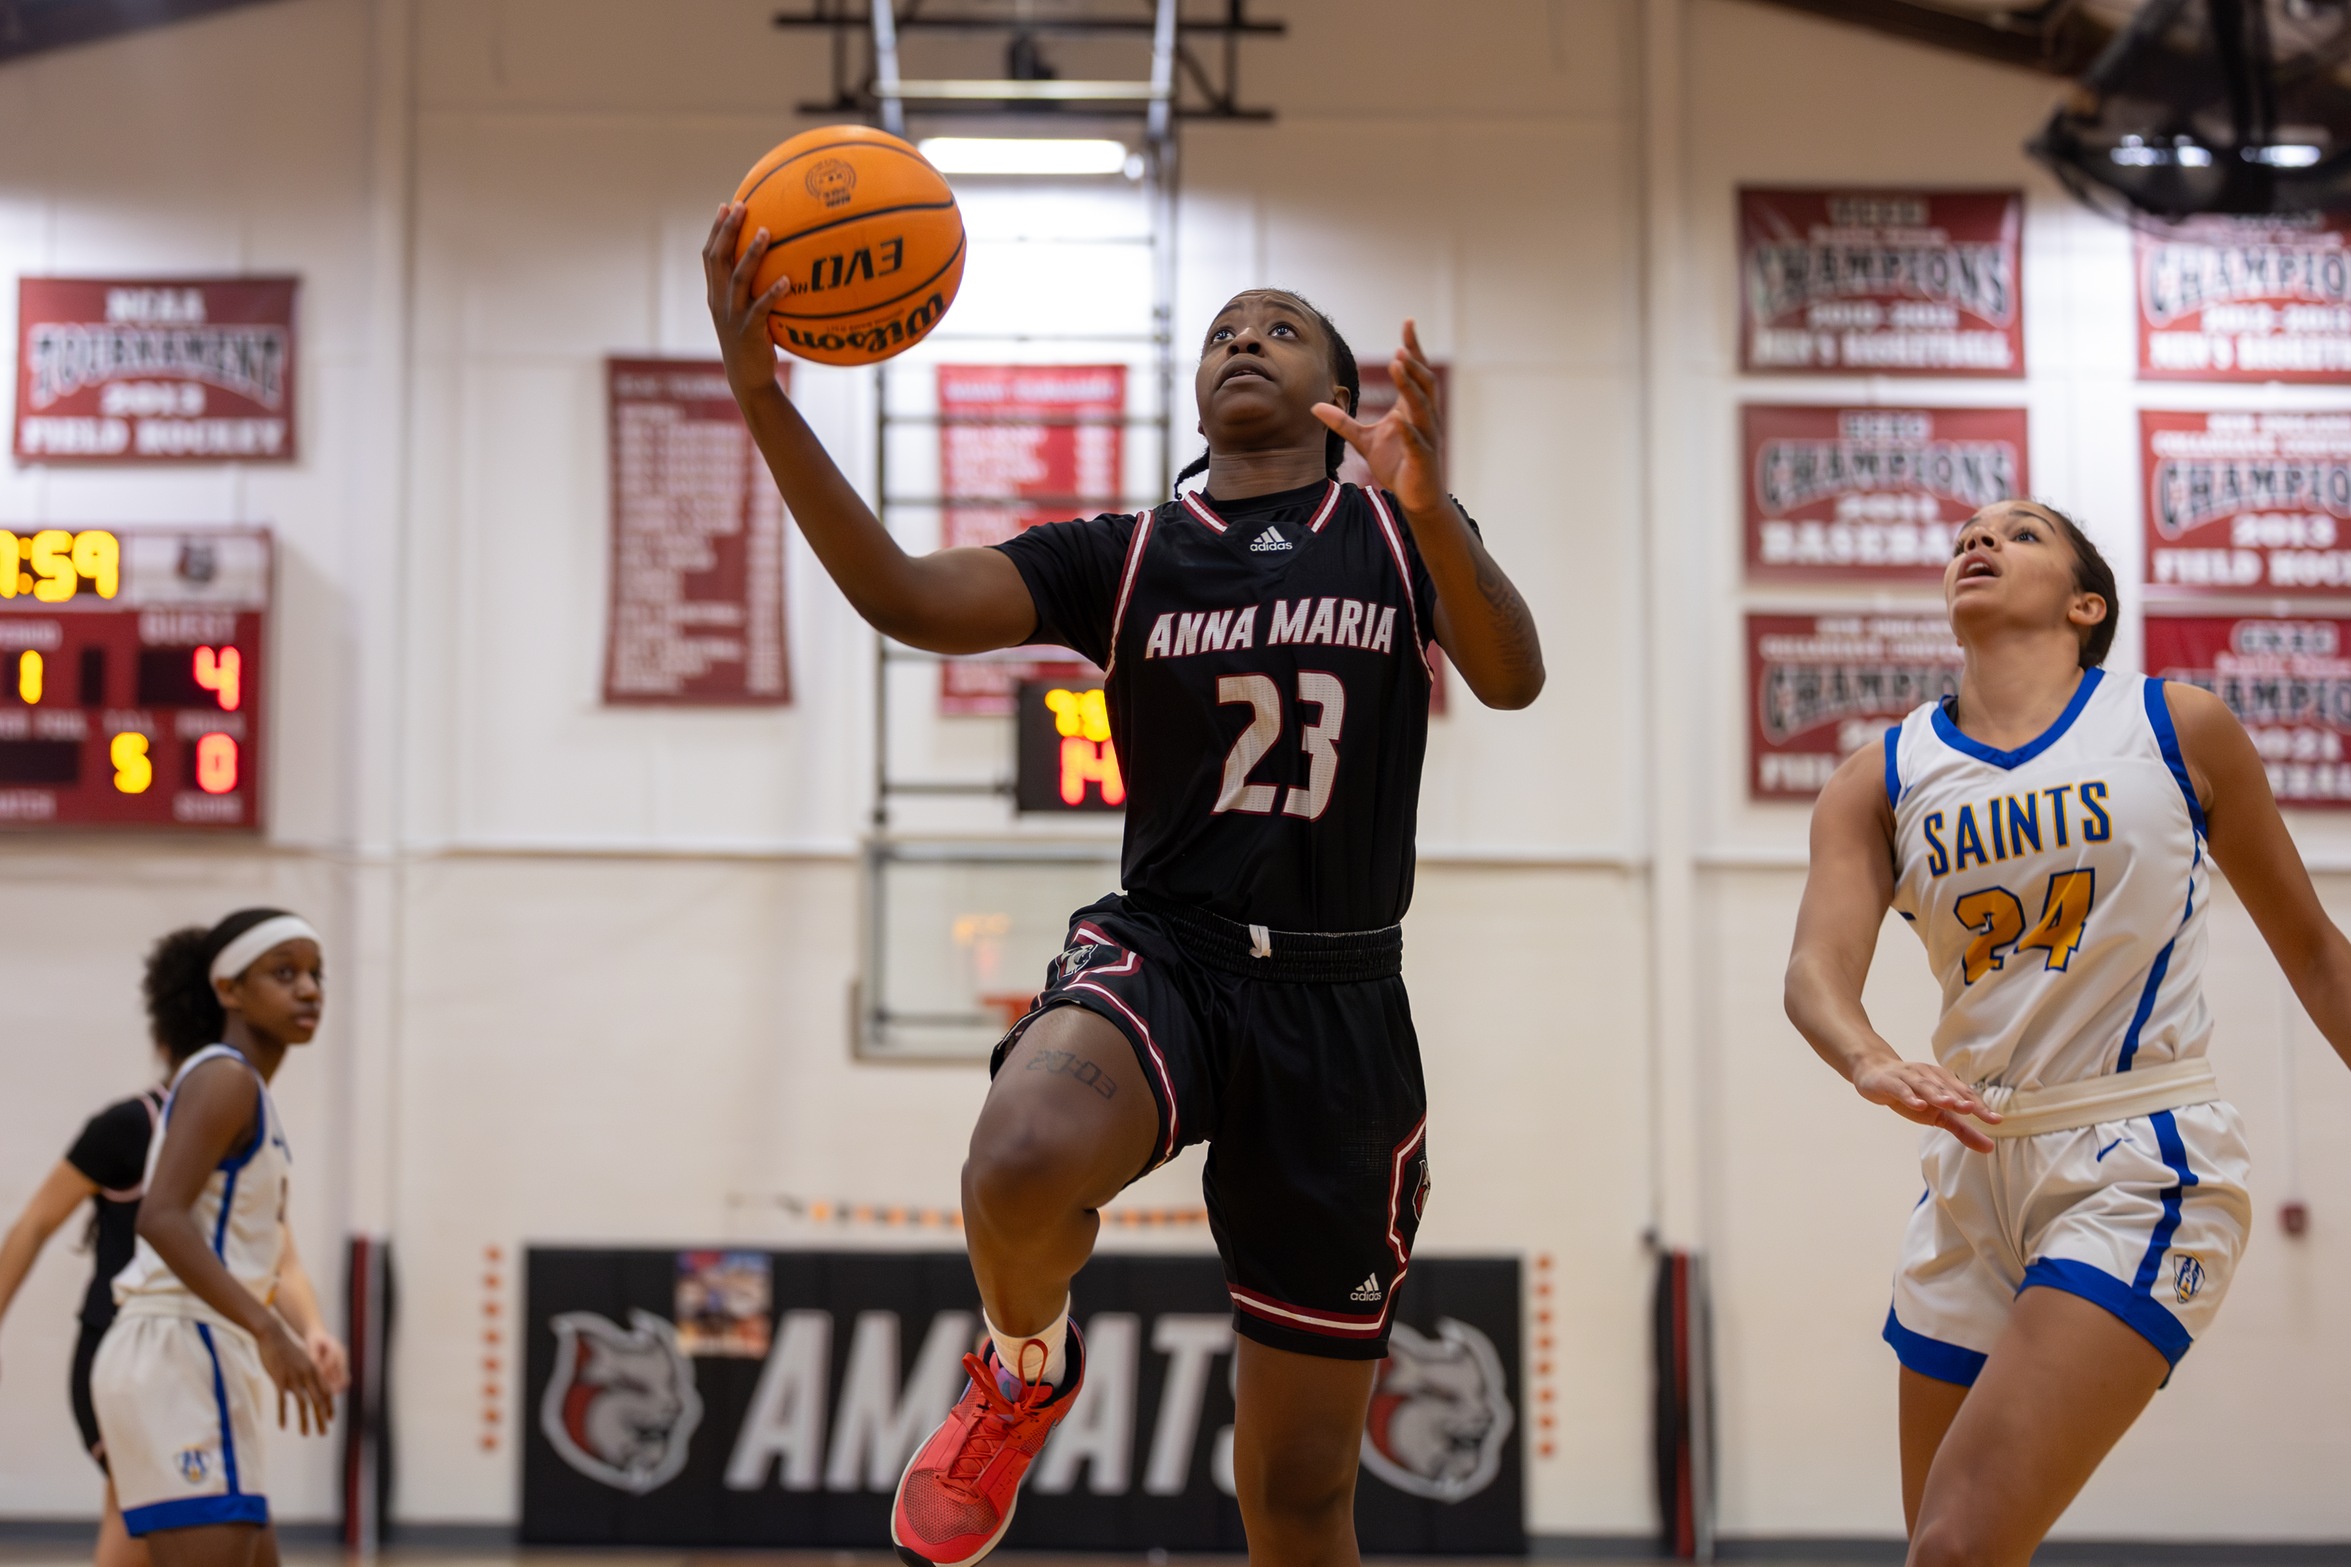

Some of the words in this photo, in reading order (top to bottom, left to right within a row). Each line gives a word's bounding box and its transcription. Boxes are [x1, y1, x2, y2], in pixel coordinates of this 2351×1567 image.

[811, 236, 903, 292] EVO
[787, 292, 946, 353] Wilson
[30, 325, 284, 408] TOURNAMENT
[23, 418, 129, 455] FIELD
[137, 418, 283, 455] HOCKEY
[1250, 540, 1293, 551] adidas
[2155, 549, 2262, 585] FIELD
[1145, 603, 1260, 660] ANNA
[1266, 597, 1397, 655] MARIA
[193, 645, 241, 712] 4
[196, 732, 238, 794] 0
[1210, 669, 1346, 822] 23
[1924, 779, 2112, 879] SAINTS
[1954, 868, 2095, 985] 24
[1350, 1291, 1382, 1301] adidas
